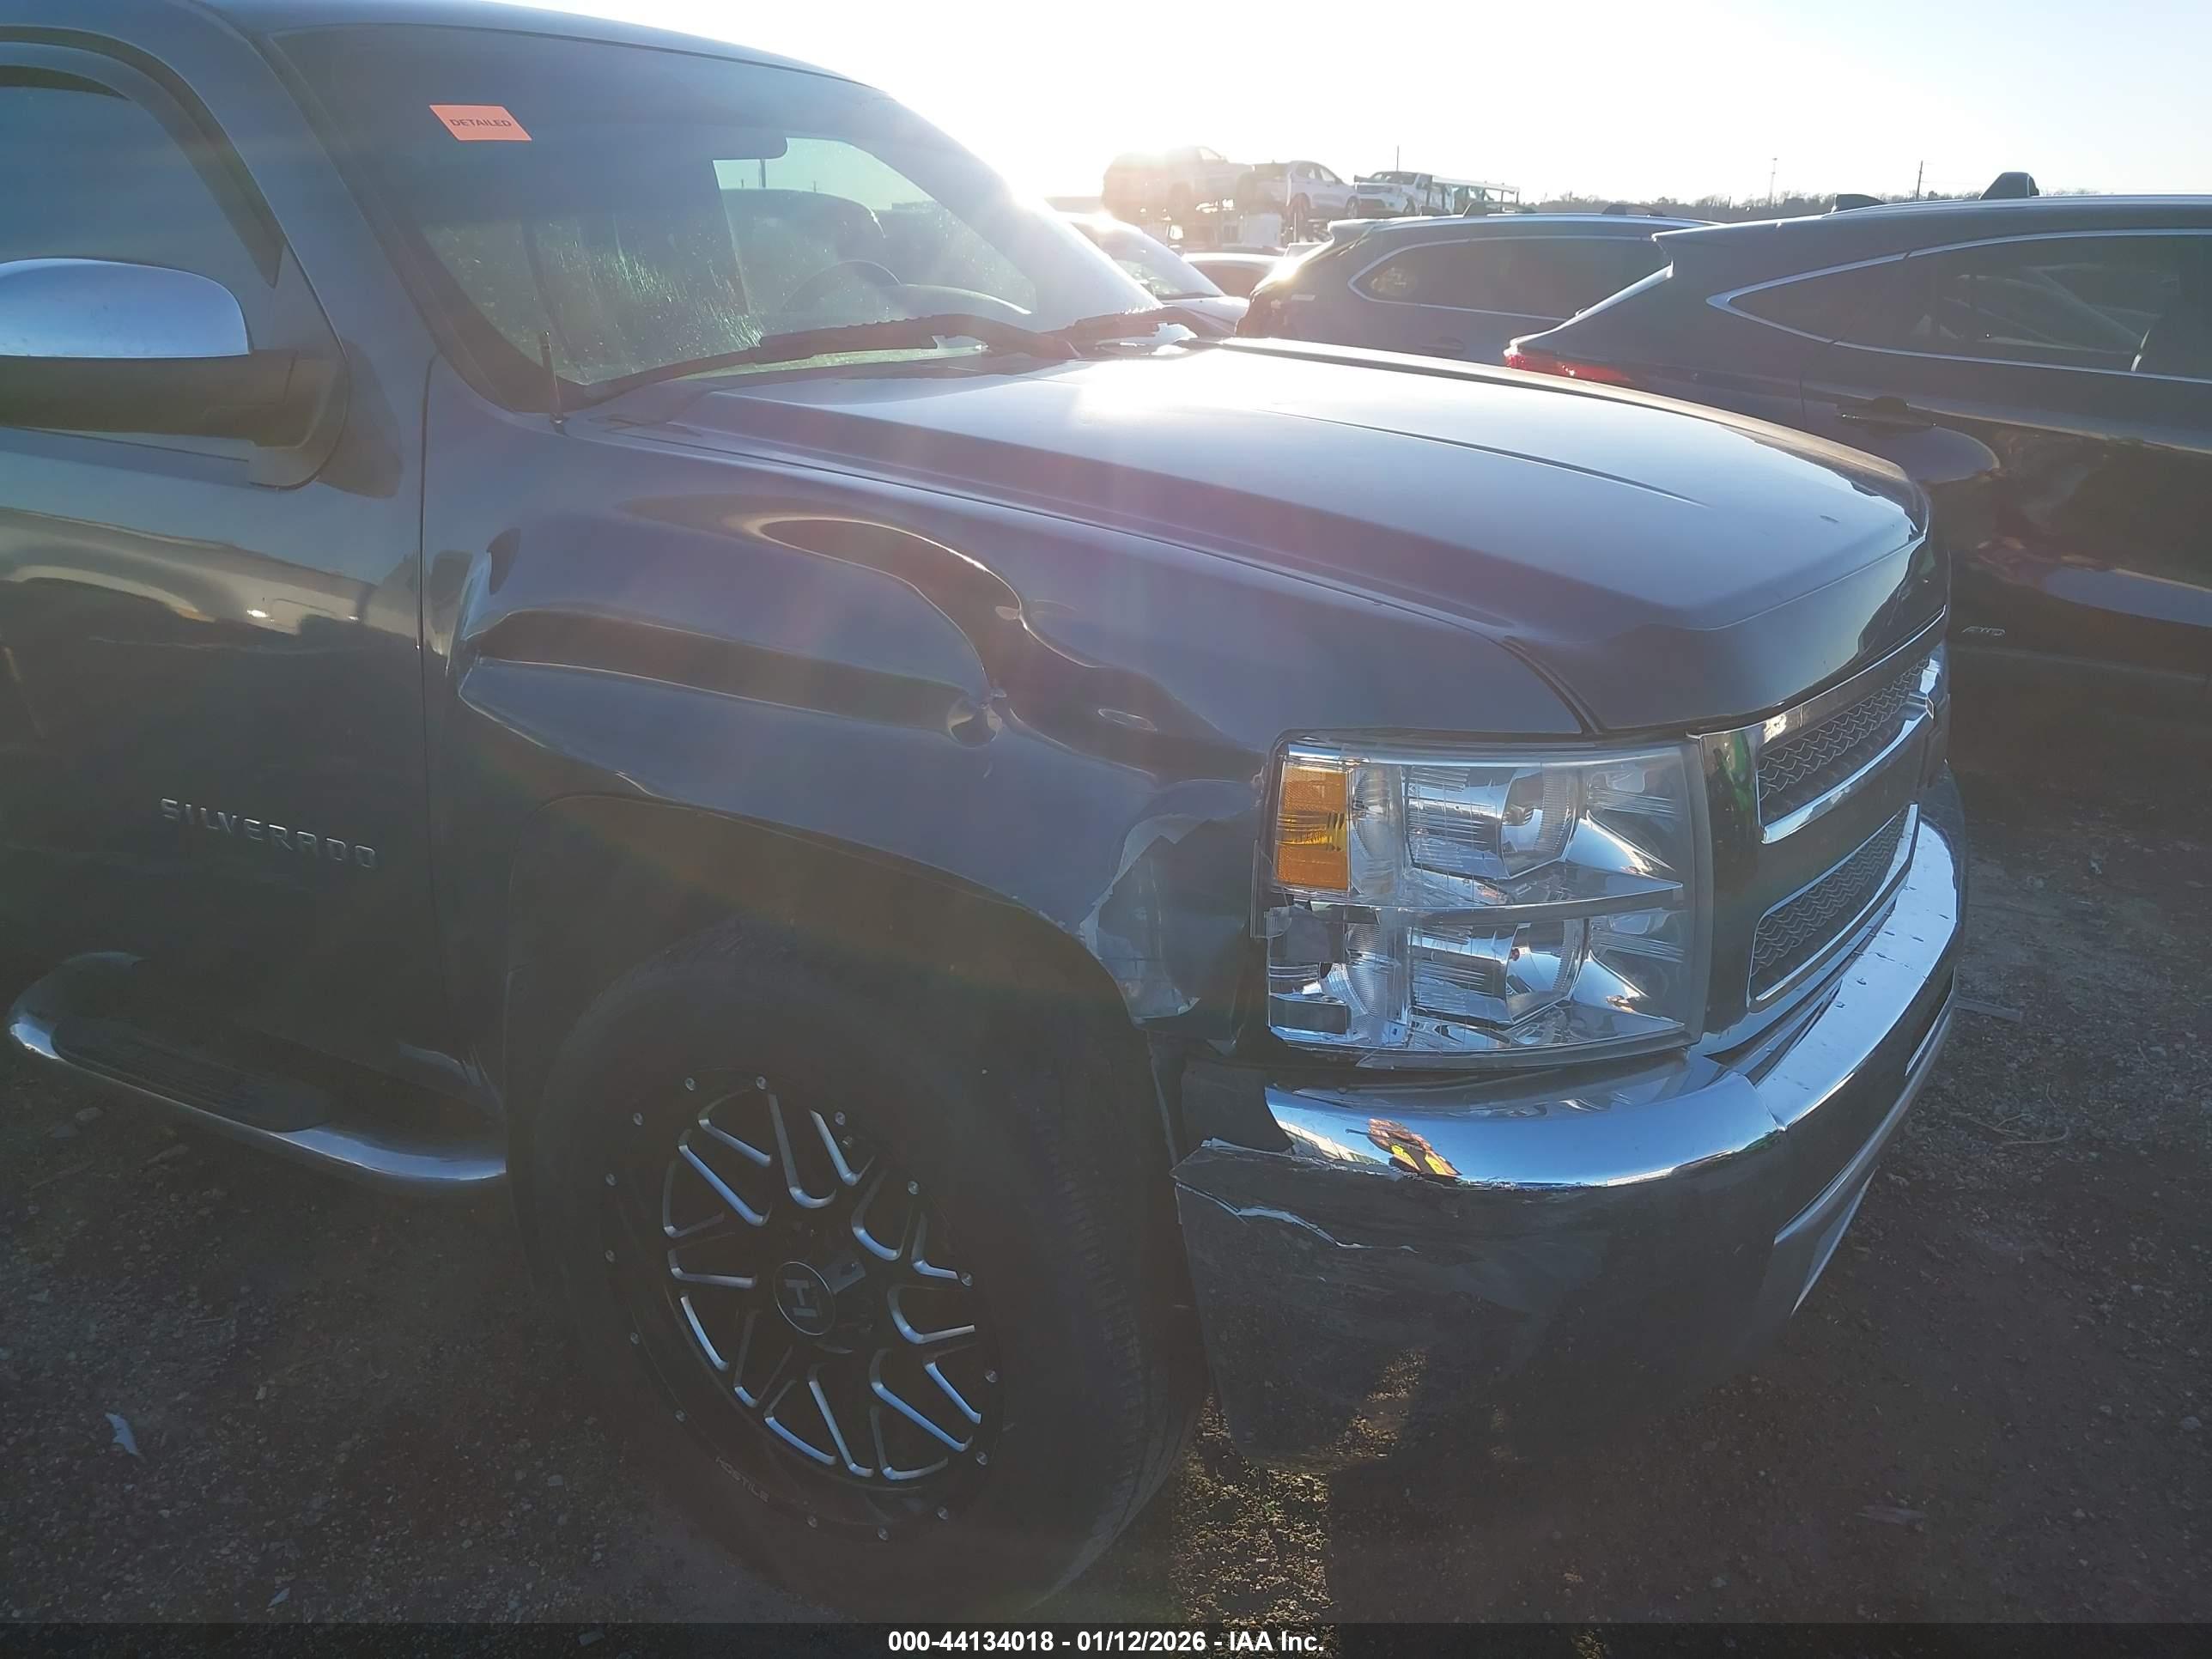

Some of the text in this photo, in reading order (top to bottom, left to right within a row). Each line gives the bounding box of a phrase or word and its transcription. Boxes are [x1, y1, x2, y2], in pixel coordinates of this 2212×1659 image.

[448, 118, 513, 128] DETAILED
[160, 797, 378, 869] SILVERADO
[714, 1455, 769, 1500] HOSTILE
